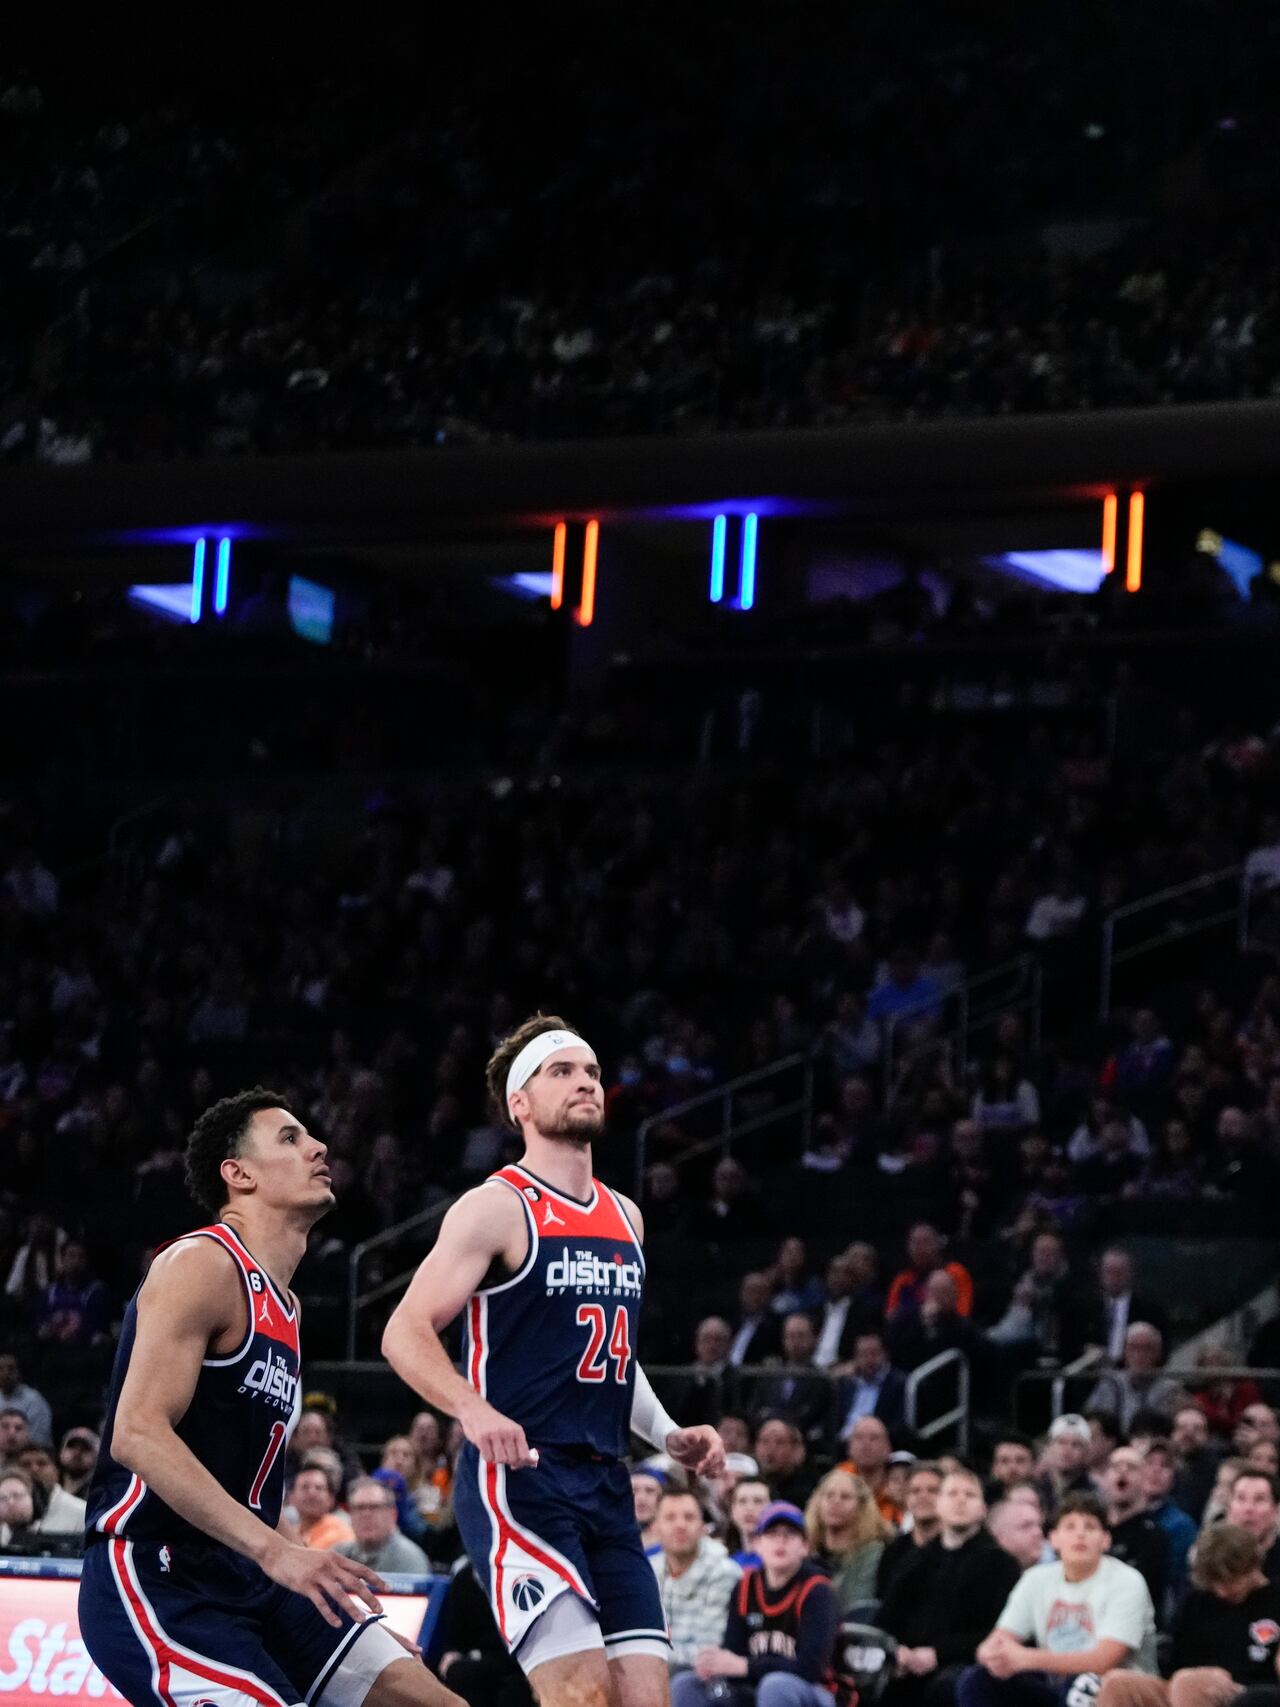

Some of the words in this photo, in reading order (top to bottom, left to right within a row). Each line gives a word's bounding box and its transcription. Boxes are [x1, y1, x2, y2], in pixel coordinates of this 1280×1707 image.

[575, 1250, 593, 1261] THE
[546, 1246, 642, 1291] district
[250, 1272, 262, 1292] 6
[546, 1286, 566, 1297] OF
[575, 1303, 632, 1385] 24
[237, 1386, 259, 1399] OF
[249, 1420, 287, 1510] 1
